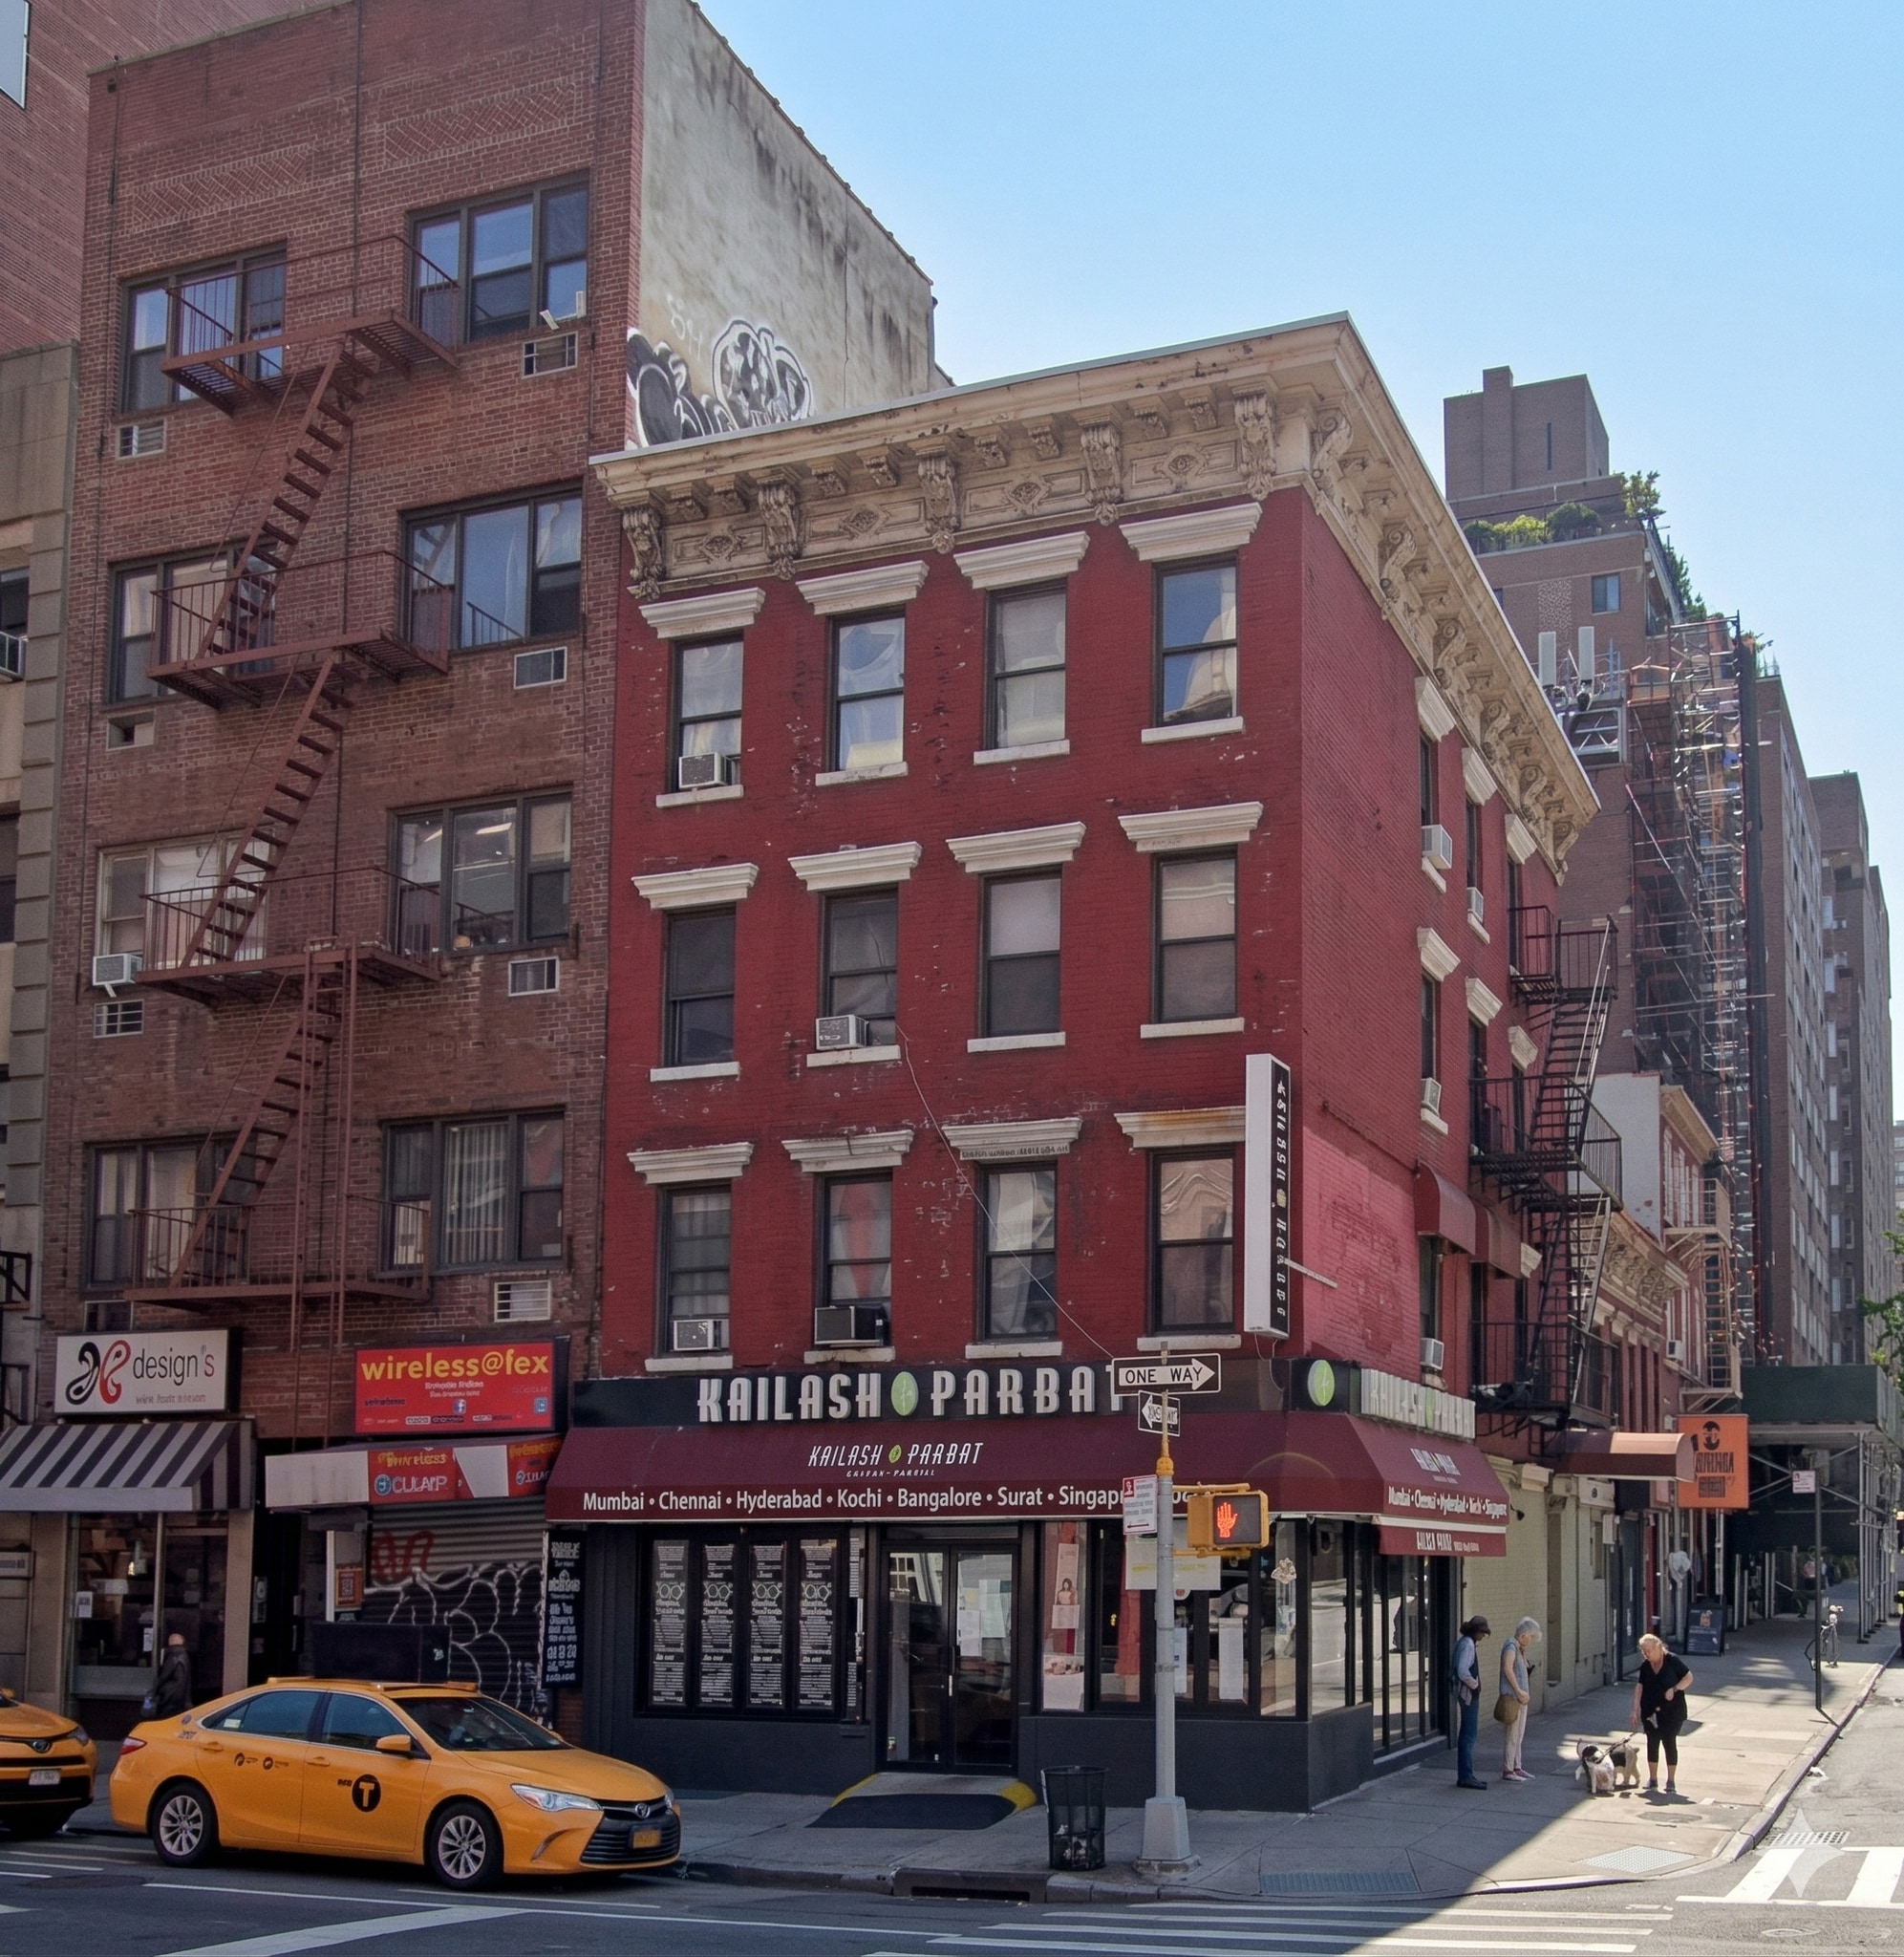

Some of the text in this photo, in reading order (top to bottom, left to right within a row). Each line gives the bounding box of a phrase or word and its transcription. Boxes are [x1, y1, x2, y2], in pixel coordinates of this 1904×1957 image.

[133, 1344, 215, 1387] design's
[361, 1348, 549, 1381] wireless@fex
[1125, 1366, 1203, 1384] ONE WAY
[697, 1373, 882, 1422] KAILASH
[808, 1443, 984, 1467] KAILASH PARBAT
[583, 1492, 645, 1511] Mumbai
[658, 1491, 721, 1510] Chennai
[737, 1489, 823, 1514] Hyderabad
[838, 1487, 882, 1508] Kochi
[897, 1486, 982, 1512] Bangalore
[997, 1486, 1043, 1506] Surat
[1059, 1485, 1123, 1510] Singap
[359, 1782, 375, 1807] T
